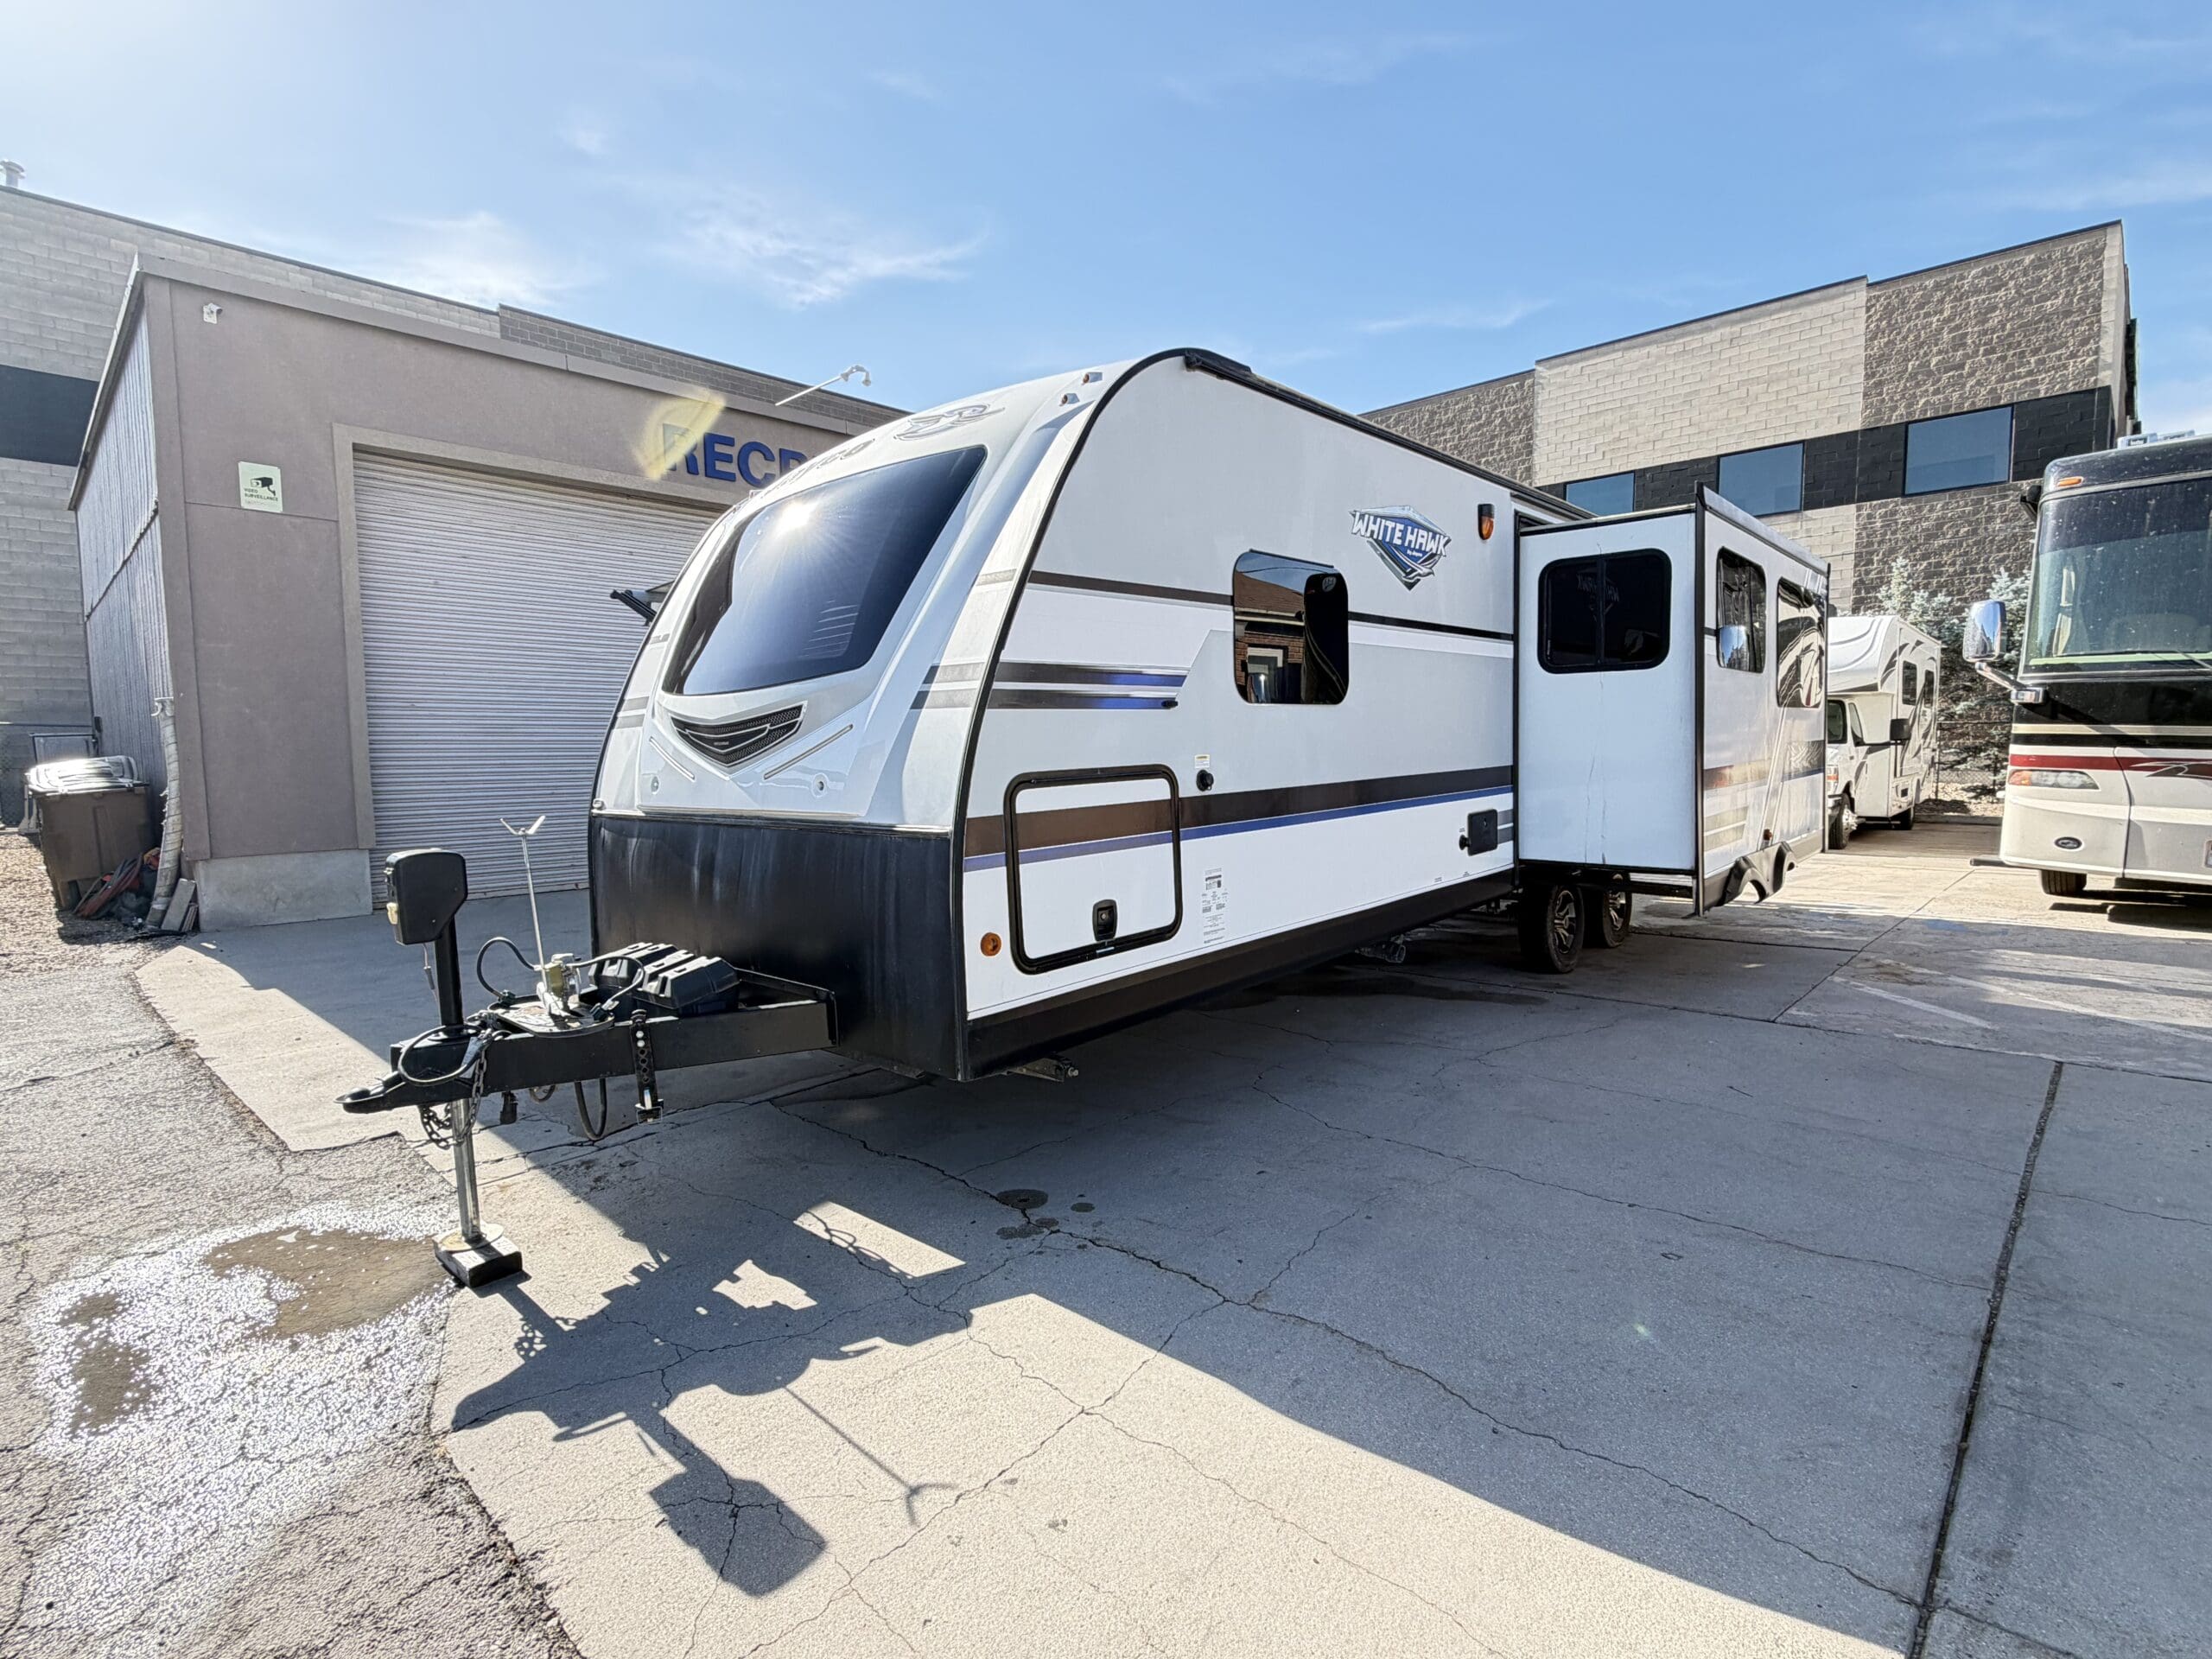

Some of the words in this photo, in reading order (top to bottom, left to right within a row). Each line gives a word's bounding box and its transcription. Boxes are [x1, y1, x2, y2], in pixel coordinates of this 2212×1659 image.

[245, 493, 278, 501] SURVEILLANCE
[1351, 511, 1405, 546] WHITE
[1404, 525, 1448, 556] HAWK
